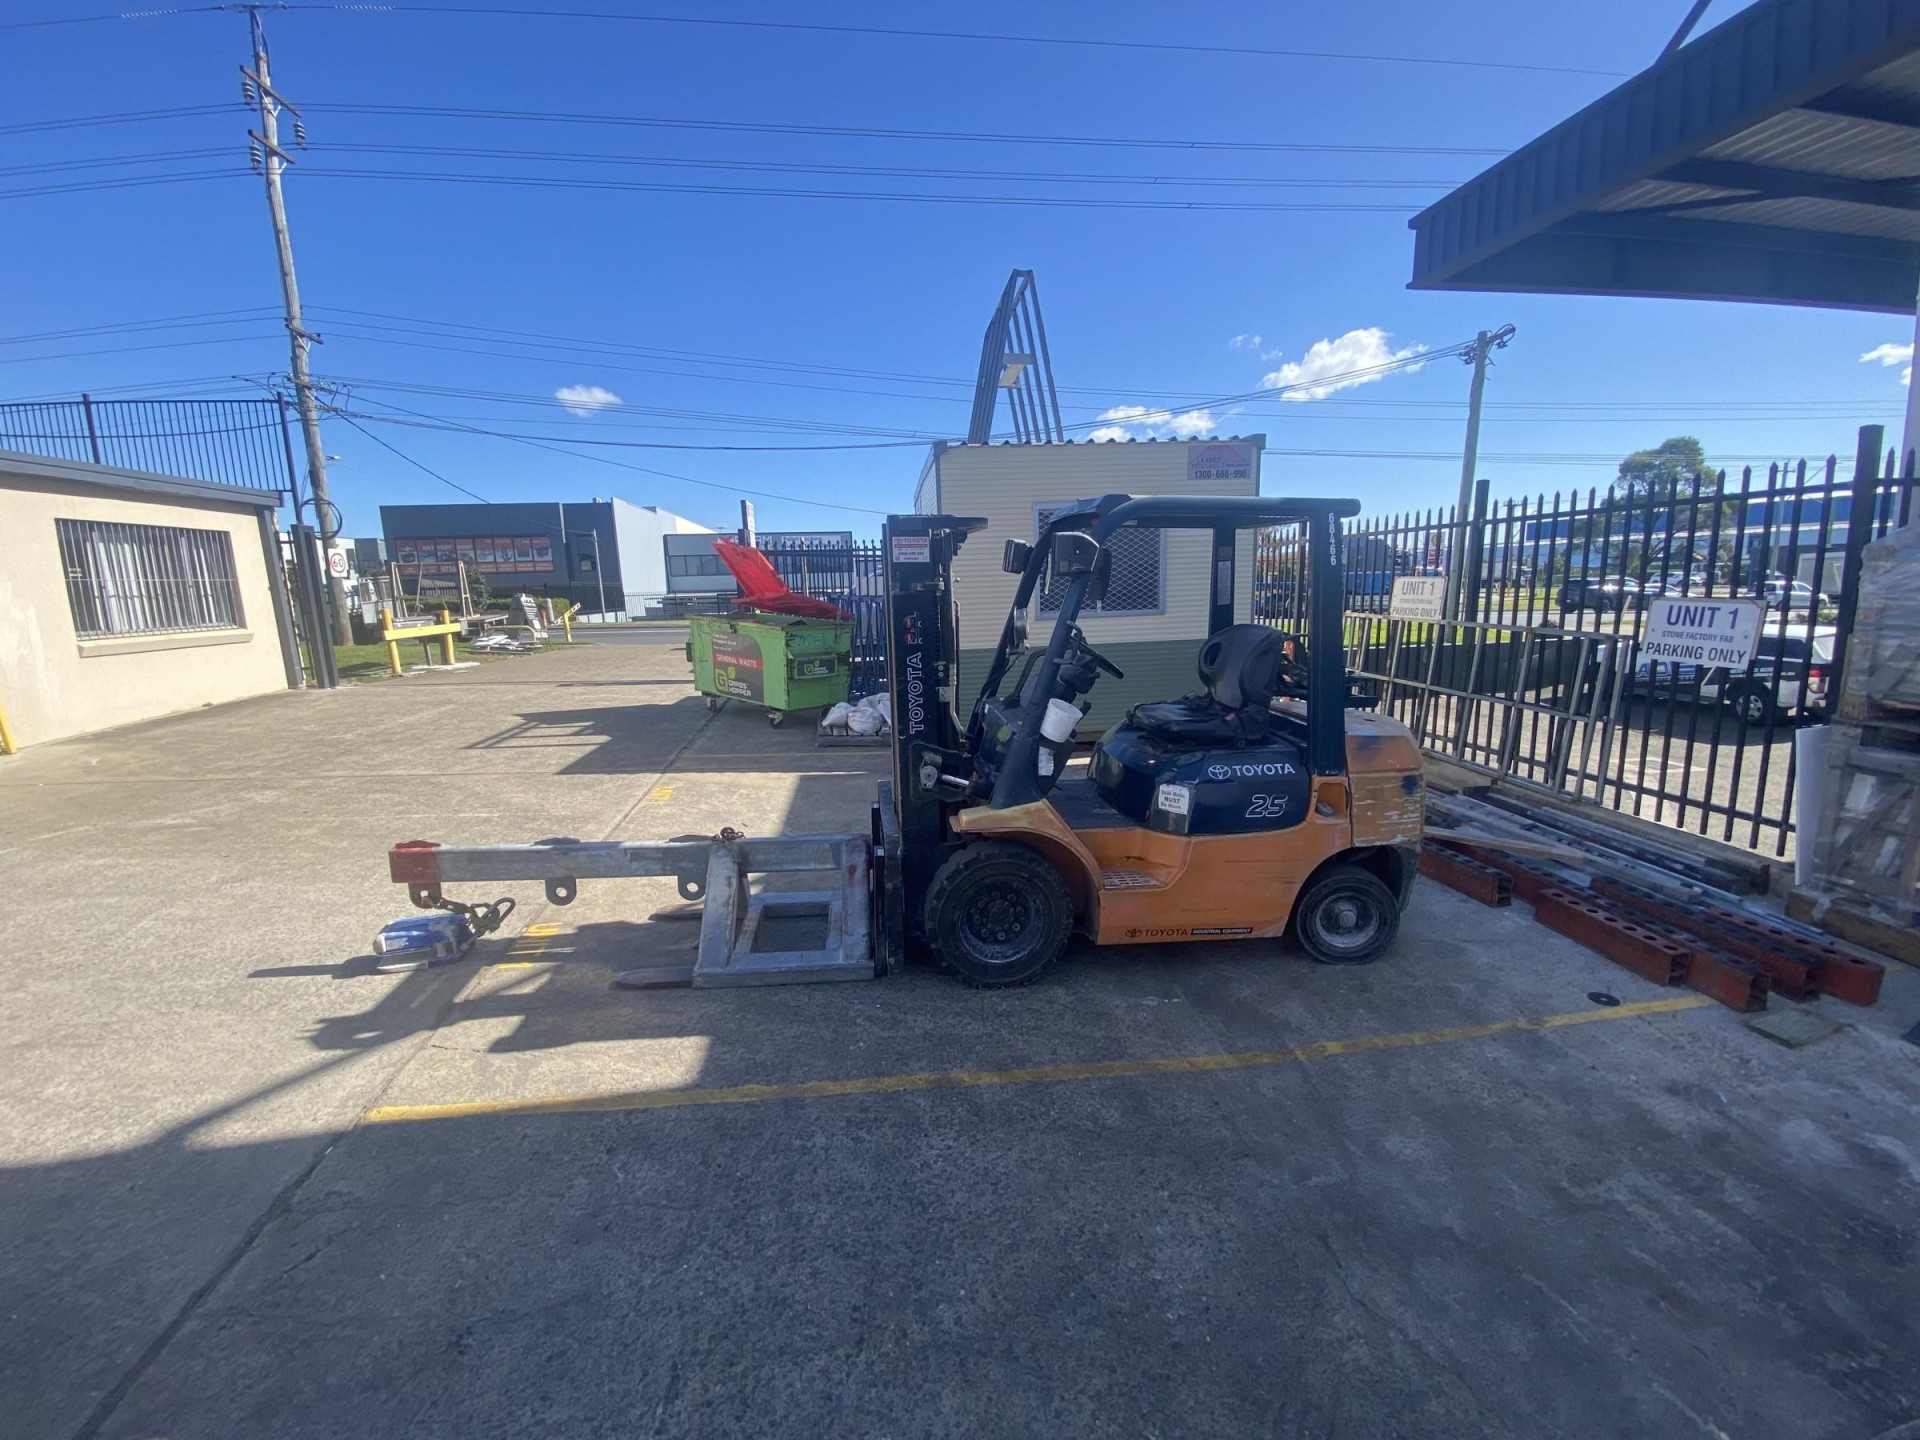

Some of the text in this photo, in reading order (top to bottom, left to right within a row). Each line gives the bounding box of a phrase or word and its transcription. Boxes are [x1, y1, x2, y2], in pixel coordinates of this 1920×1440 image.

[333, 558, 344, 568] 60
[1402, 581, 1436, 596] UNIT 1
[1392, 607, 1439, 618] PARKING ONLY
[1666, 604, 1740, 630] UNIT 1
[1662, 630, 1734, 643] STONE FACTORY FAB
[1645, 642, 1746, 664] PARKING ONLY
[716, 654, 758, 668] GENERAL WASTE
[907, 652, 924, 734] TOYOTA
[1232, 763, 1296, 777] TOYOTA
[1164, 796, 1181, 804] MUST
[1245, 794, 1289, 818] 25
[1145, 928, 1188, 937] TOYOTA
